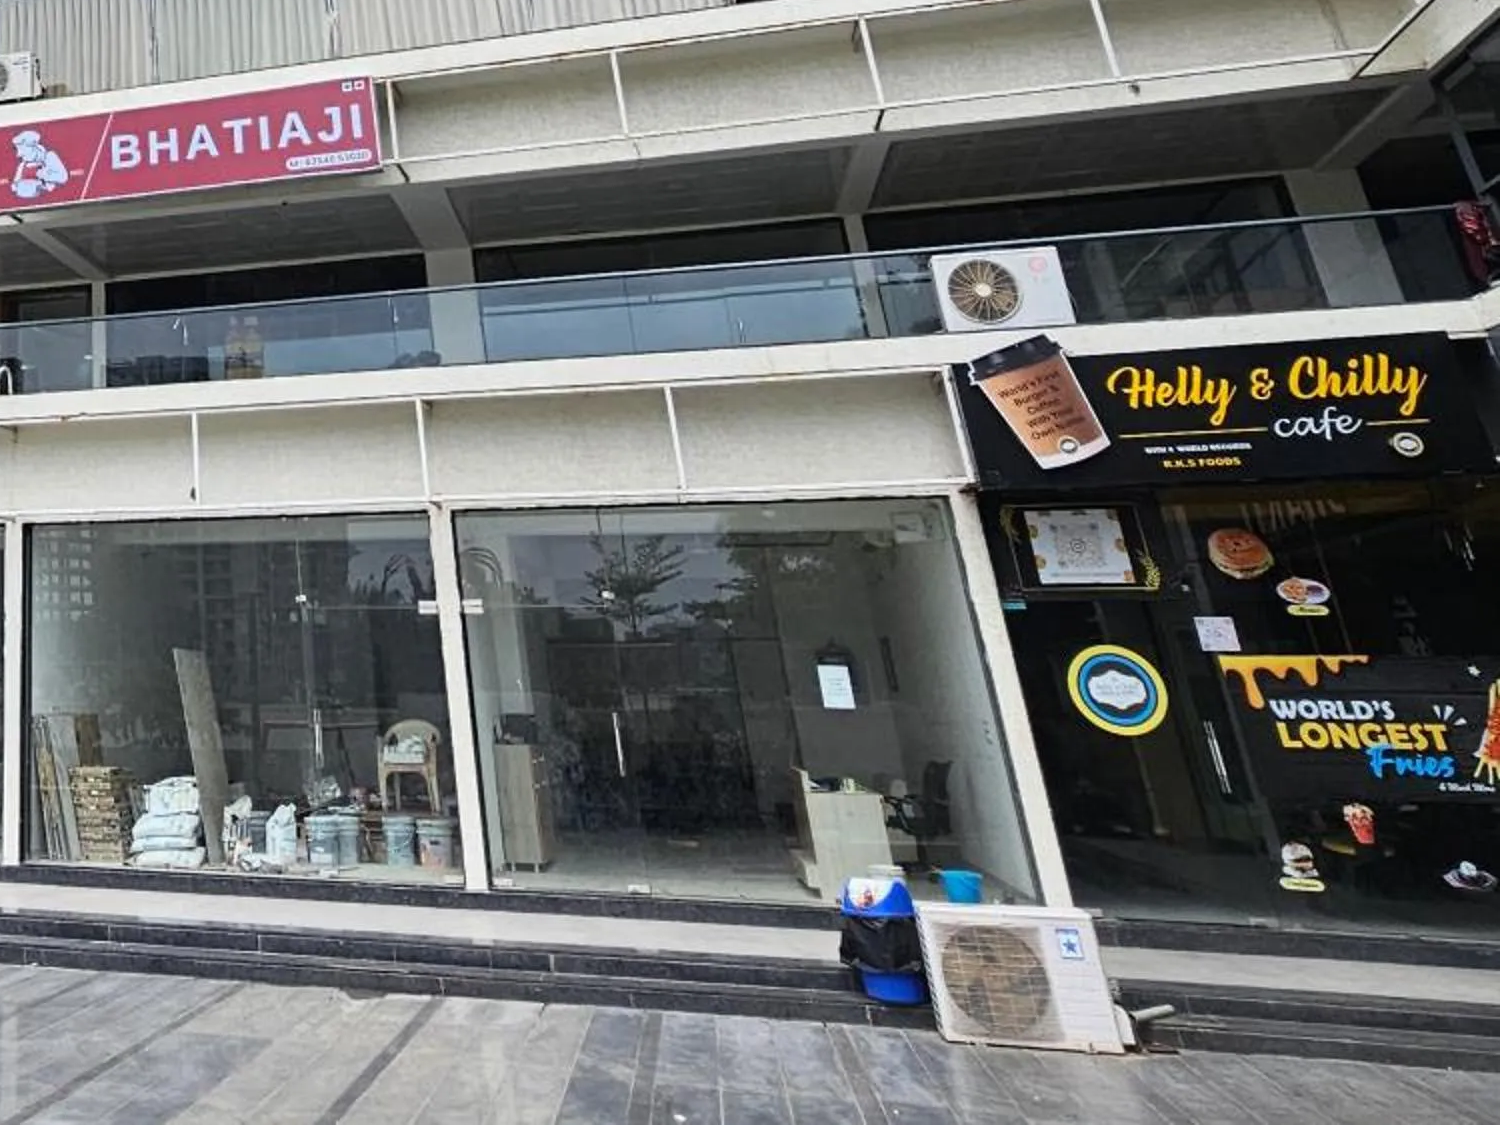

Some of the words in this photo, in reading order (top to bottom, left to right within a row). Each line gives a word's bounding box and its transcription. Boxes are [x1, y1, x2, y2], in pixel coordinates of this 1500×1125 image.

[110, 102, 365, 170] BHATIAJI
[1106, 365, 1237, 426] Helly
[1250, 368, 1275, 400] &
[1288, 353, 1428, 416] Chilly
[1273, 406, 1362, 441] cafe
[1198, 457, 1241, 467] FOODS
[1269, 698, 1396, 721] WORLD'S
[1275, 721, 1448, 752] LONGEST
[1364, 743, 1455, 779] Fries
